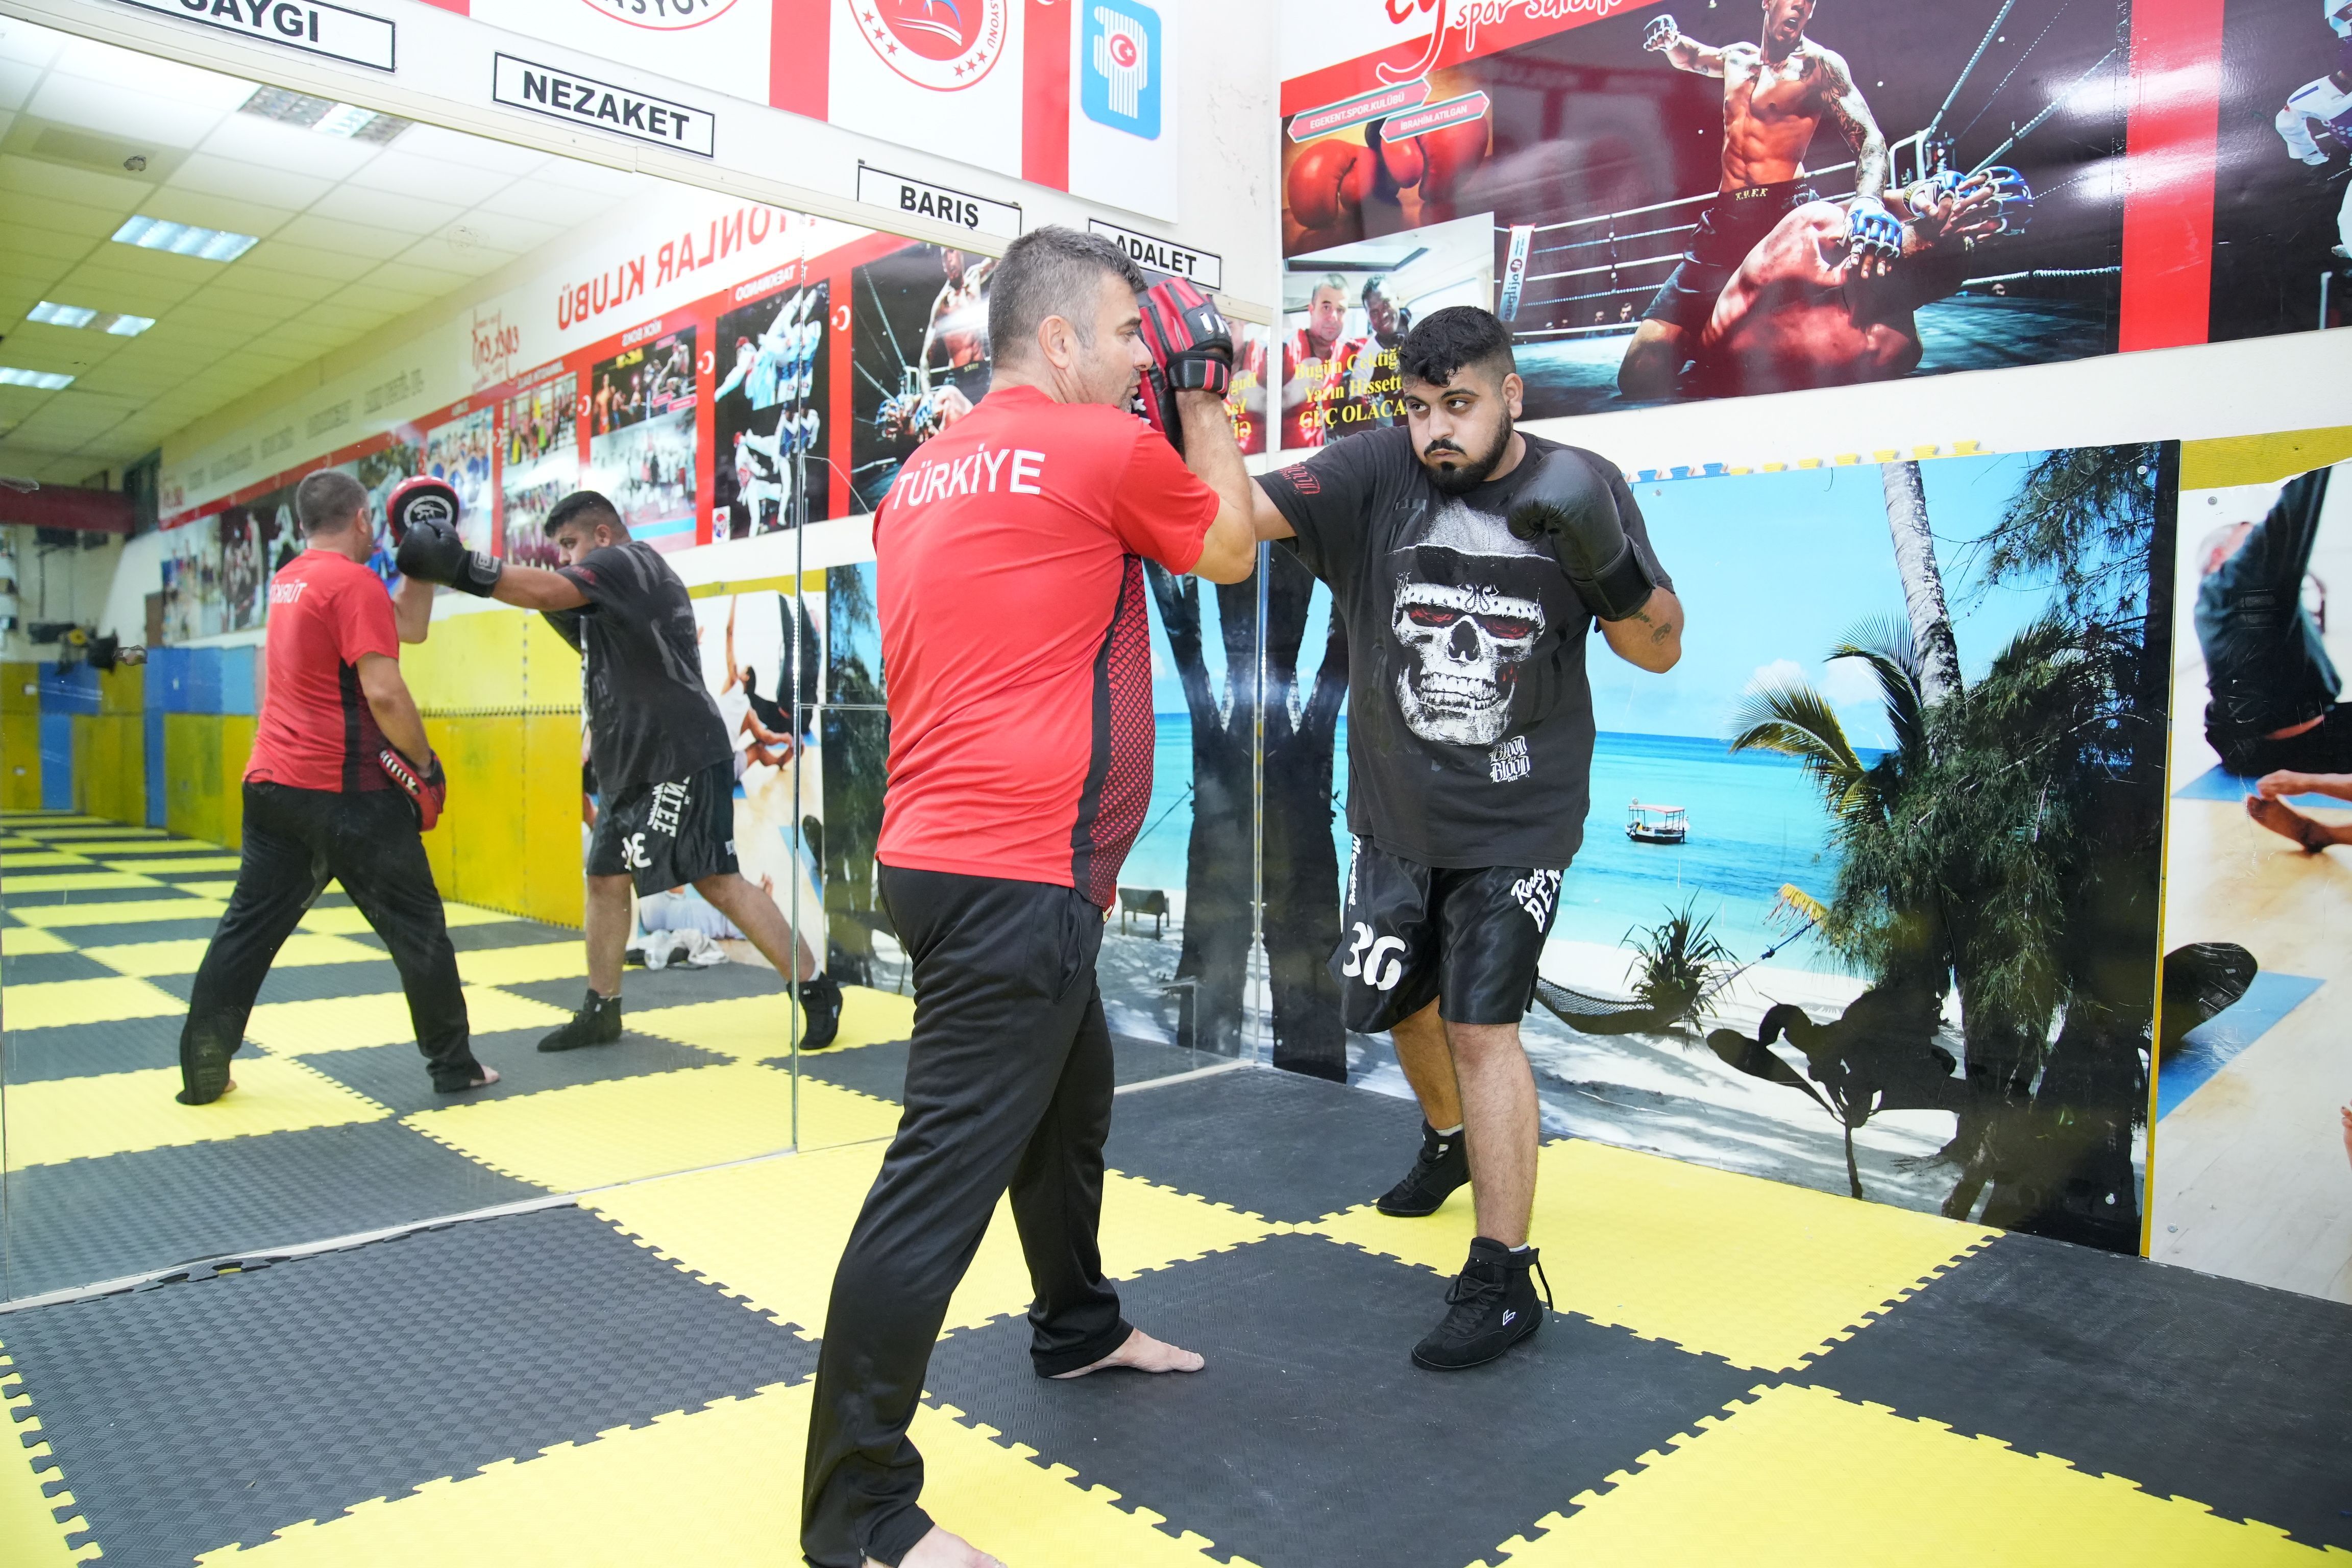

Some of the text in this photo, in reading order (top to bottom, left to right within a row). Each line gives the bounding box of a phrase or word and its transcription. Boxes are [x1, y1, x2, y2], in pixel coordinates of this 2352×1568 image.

[987, 0, 999, 49] SYONU
[524, 70, 689, 140] NEZAKET
[1309, 91, 1405, 130] EGEKENT.SPOR.KULÜBÜ
[1400, 104, 1468, 131] İBRAHİM.ATILGAN
[900, 185, 978, 231] BARIŞ
[1116, 234, 1196, 276] ADALET
[1295, 346, 1402, 381] Bugün Çektiğ
[1299, 398, 1407, 429] GÜÇ OLACA
[1305, 385, 1344, 403] Yarın
[893, 443, 1046, 510] TÜRKİYE
[1342, 921, 1406, 991] 36
